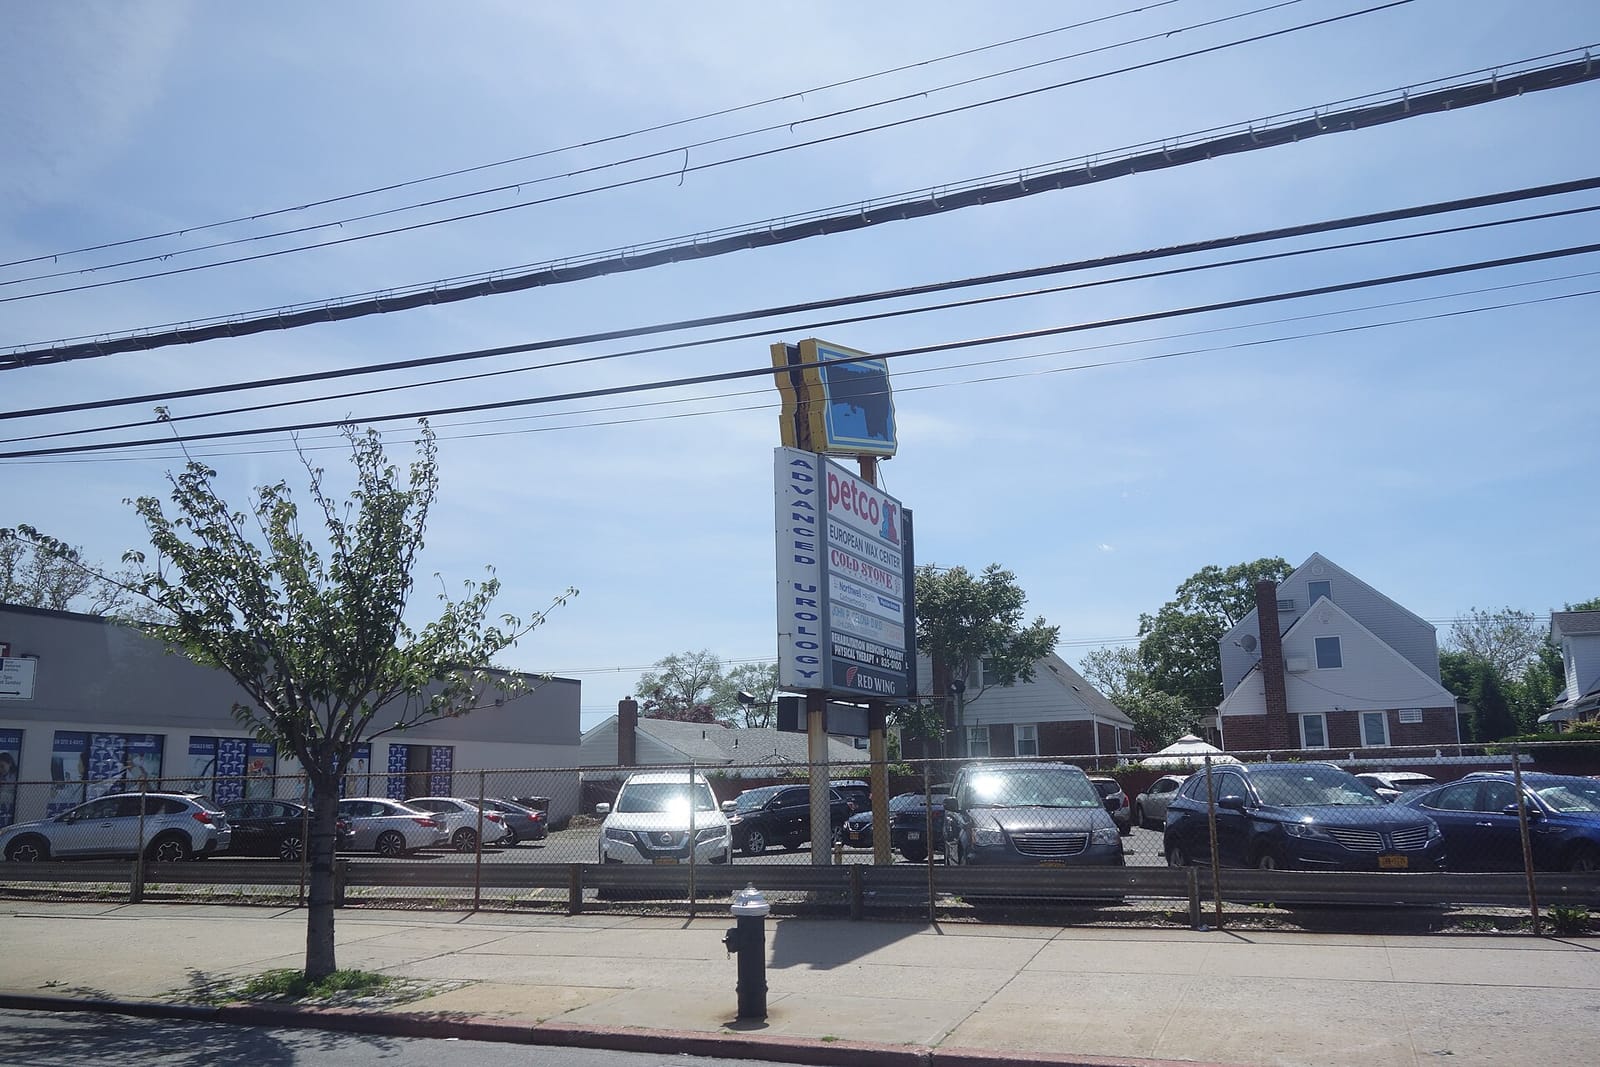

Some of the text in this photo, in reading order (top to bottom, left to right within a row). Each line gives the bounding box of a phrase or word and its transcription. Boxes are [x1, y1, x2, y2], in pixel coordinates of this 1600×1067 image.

[827, 471, 880, 525] petco
[829, 524, 901, 568] EUROPEAN WAX CENTER
[789, 459, 819, 678] ADVANCED UROLOGY
[831, 549, 859, 572] COLD
[861, 562, 893, 589] STONE
[839, 581, 862, 598] Northwell
[831, 631, 904, 661] REHABILITATION MEDICINE PODIATRY
[834, 644, 856, 659] PHYSICAL
[856, 651, 875, 664] THERAPY
[857, 673, 896, 694] RED WING
